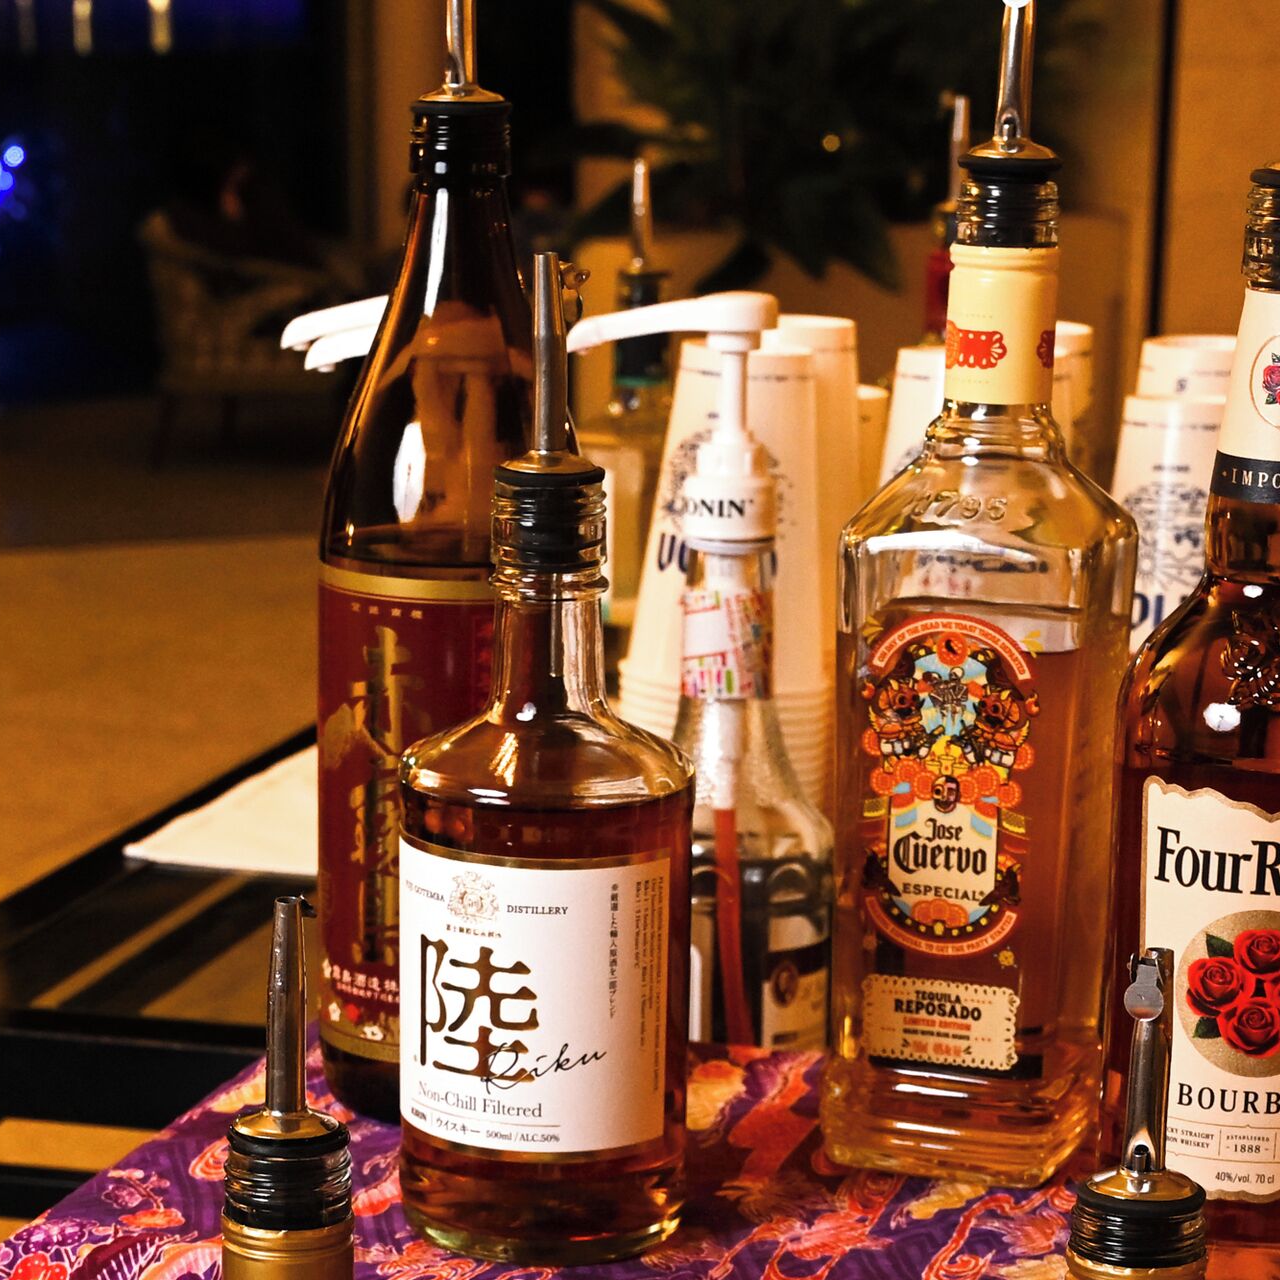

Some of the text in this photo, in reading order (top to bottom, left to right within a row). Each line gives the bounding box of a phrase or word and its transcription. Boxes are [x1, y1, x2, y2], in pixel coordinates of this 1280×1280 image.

[924, 817, 963, 842] Jose
[893, 830, 987, 875] Cuervo
[1154, 826, 1252, 894] Four
[901, 882, 980, 902] ESPECIAL
[506, 904, 568, 915] DISTILLERY
[915, 990, 962, 1004] TEQUILA
[894, 998, 982, 1021] REPOSADO
[480, 1042, 607, 1095] Riku
[418, 1081, 543, 1118] Non-Chill Filtered
[435, 1117, 481, 1135] ウイスキー
[1180, 1129, 1215, 1141] STRAIGHT
[1180, 1139, 1210, 1149] WHISKEY
[1255, 1173, 1266, 1184] 70
[1267, 1173, 1276, 1184] cl
